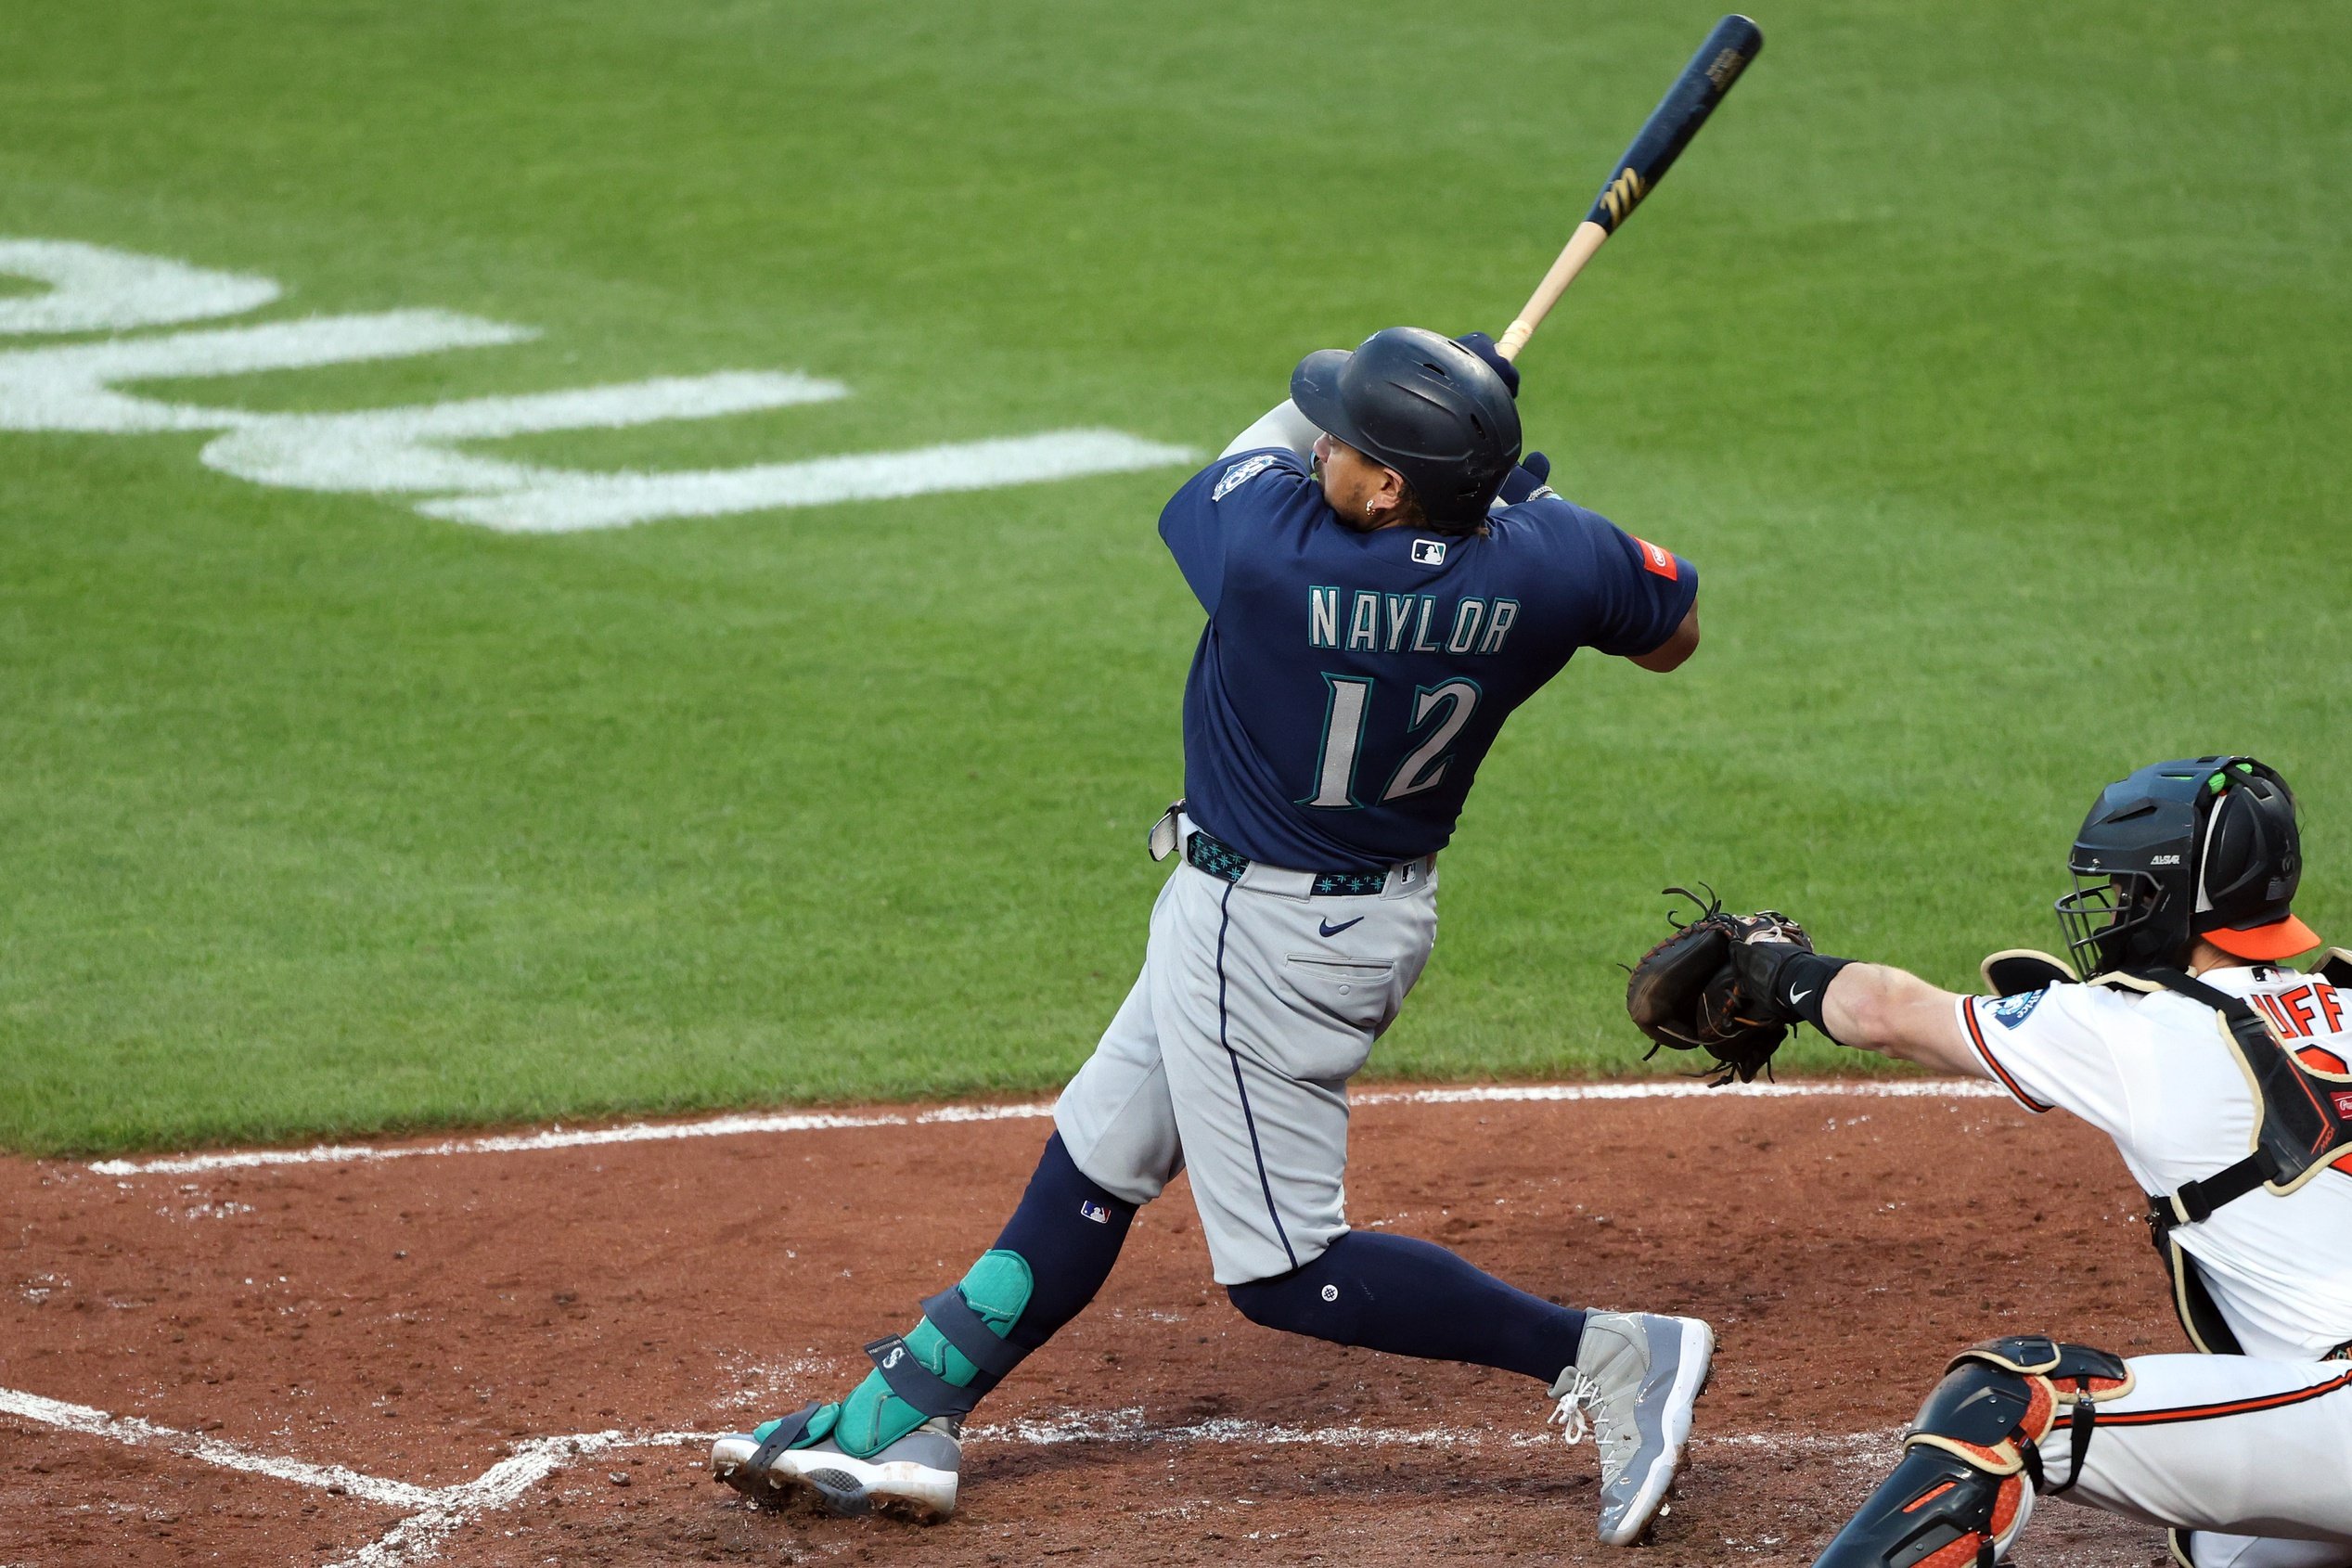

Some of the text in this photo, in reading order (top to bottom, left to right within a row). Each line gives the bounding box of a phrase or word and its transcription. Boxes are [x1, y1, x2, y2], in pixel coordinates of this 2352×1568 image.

[1308, 585, 1521, 655] NAYLOR
[1293, 671, 1483, 811] 12
[2241, 983, 2344, 1040] UFF
